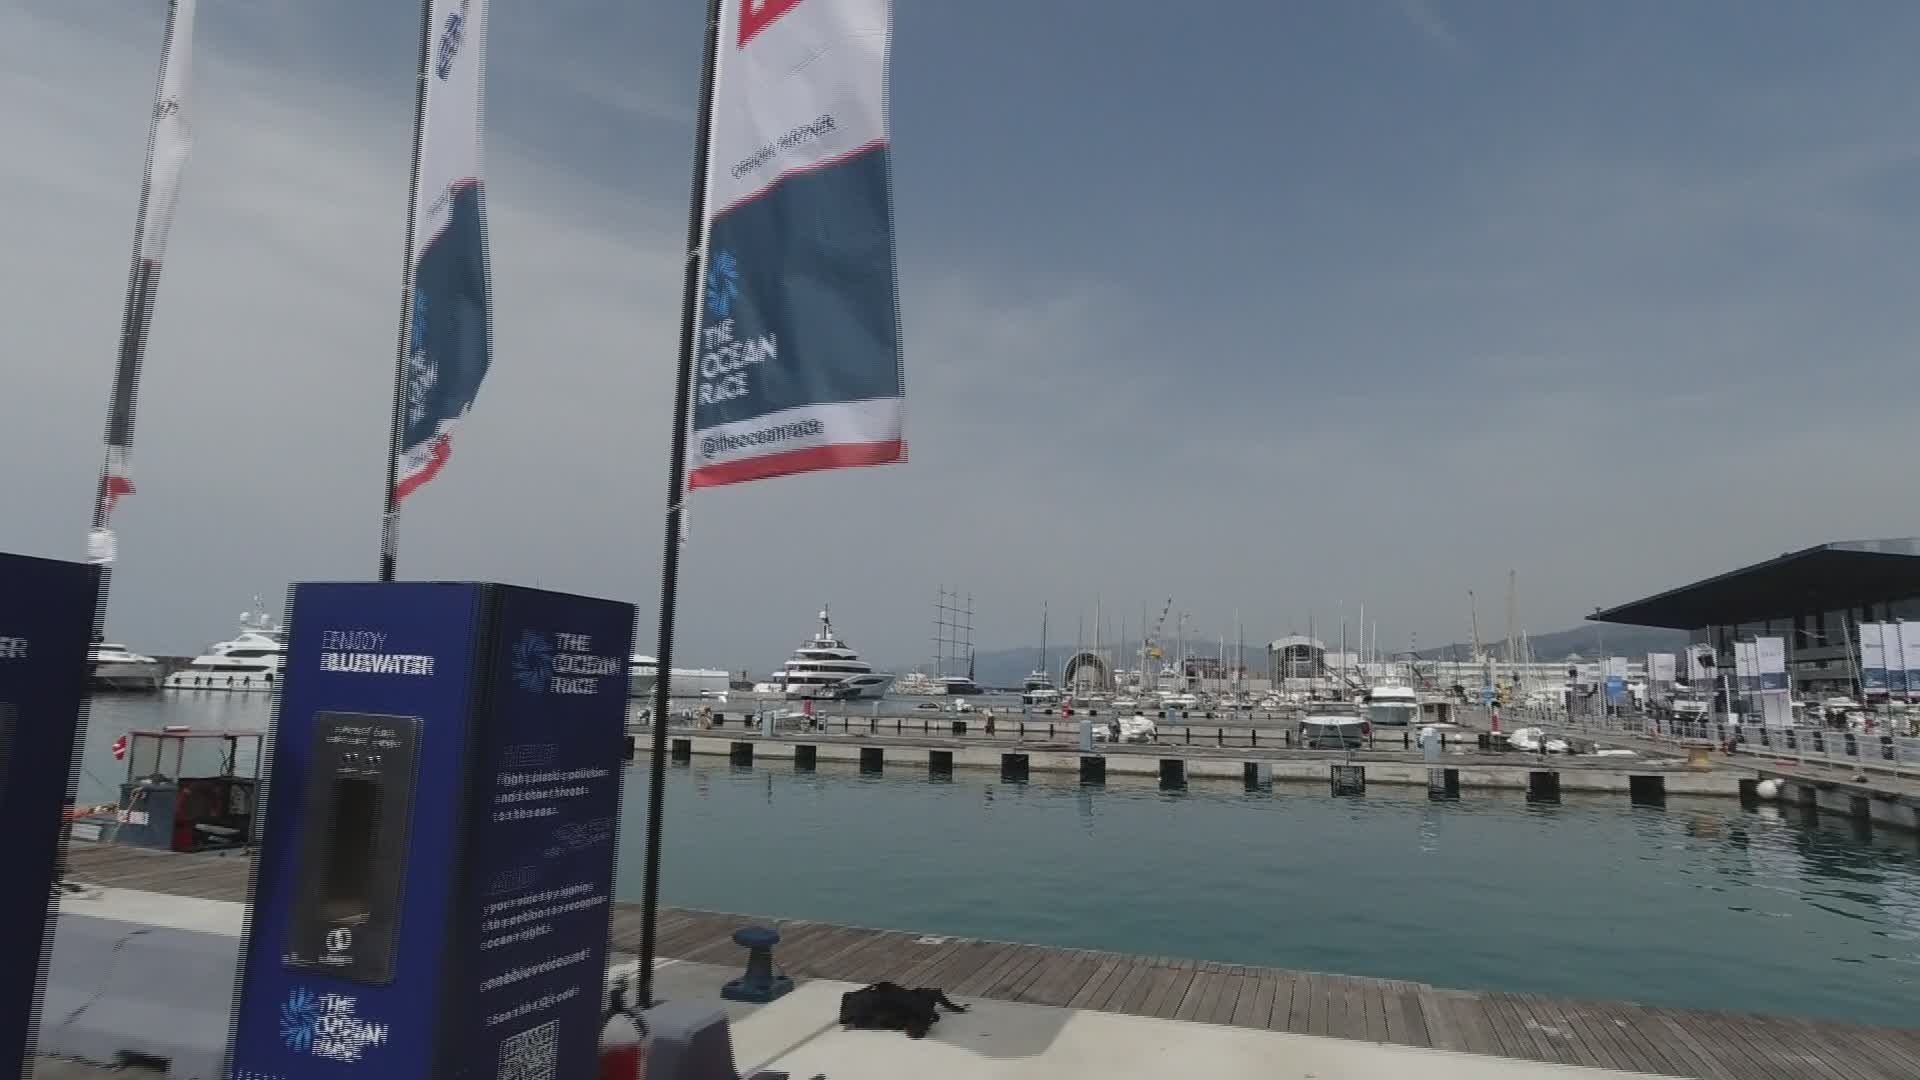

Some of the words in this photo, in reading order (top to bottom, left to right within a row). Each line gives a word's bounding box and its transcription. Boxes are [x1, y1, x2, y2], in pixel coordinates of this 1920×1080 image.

[731, 143, 776, 180] OFFICIAL
[777, 113, 836, 152] PARTNER
[703, 318, 735, 351] THE
[701, 332, 777, 379] OCEAN
[699, 371, 750, 405] RACE
[702, 418, 825, 459] @theoceanrace
[321, 630, 388, 650] ENJOY
[555, 632, 593, 652] THE
[320, 652, 434, 676] BLUEWATER
[551, 653, 621, 675] OCEAN
[550, 676, 600, 694] RACE
[562, 767, 609, 781] pollution
[480, 948, 591, 992] onebluevoice.net
[318, 993, 357, 1017] THE
[315, 1015, 389, 1047] OCEAN
[312, 1037, 363, 1063] RACE
